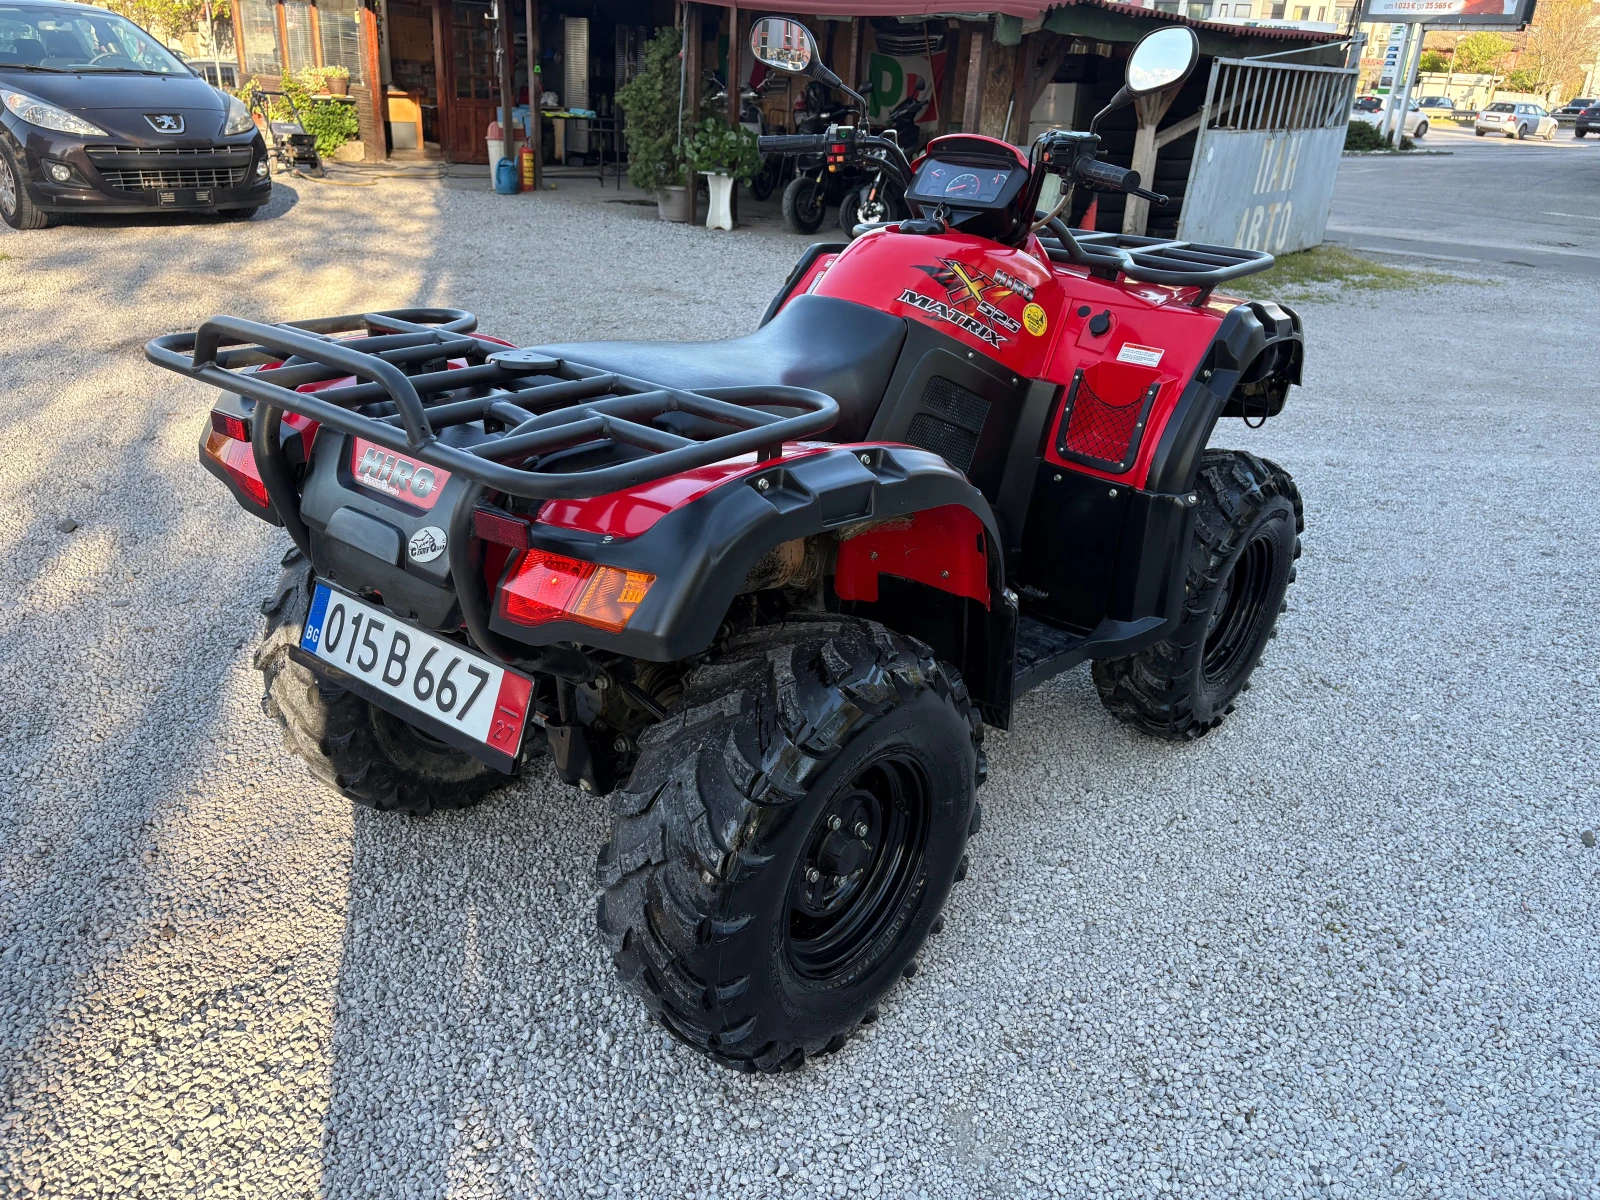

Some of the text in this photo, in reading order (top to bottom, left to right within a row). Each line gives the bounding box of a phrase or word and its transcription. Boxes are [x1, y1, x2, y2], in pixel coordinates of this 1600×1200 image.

[993, 268, 1035, 302] HIRO
[895, 288, 1011, 350] MATRIX
[977, 301, 1021, 334] 525
[305, 624, 320, 643] BG
[493, 720, 516, 744] 27
